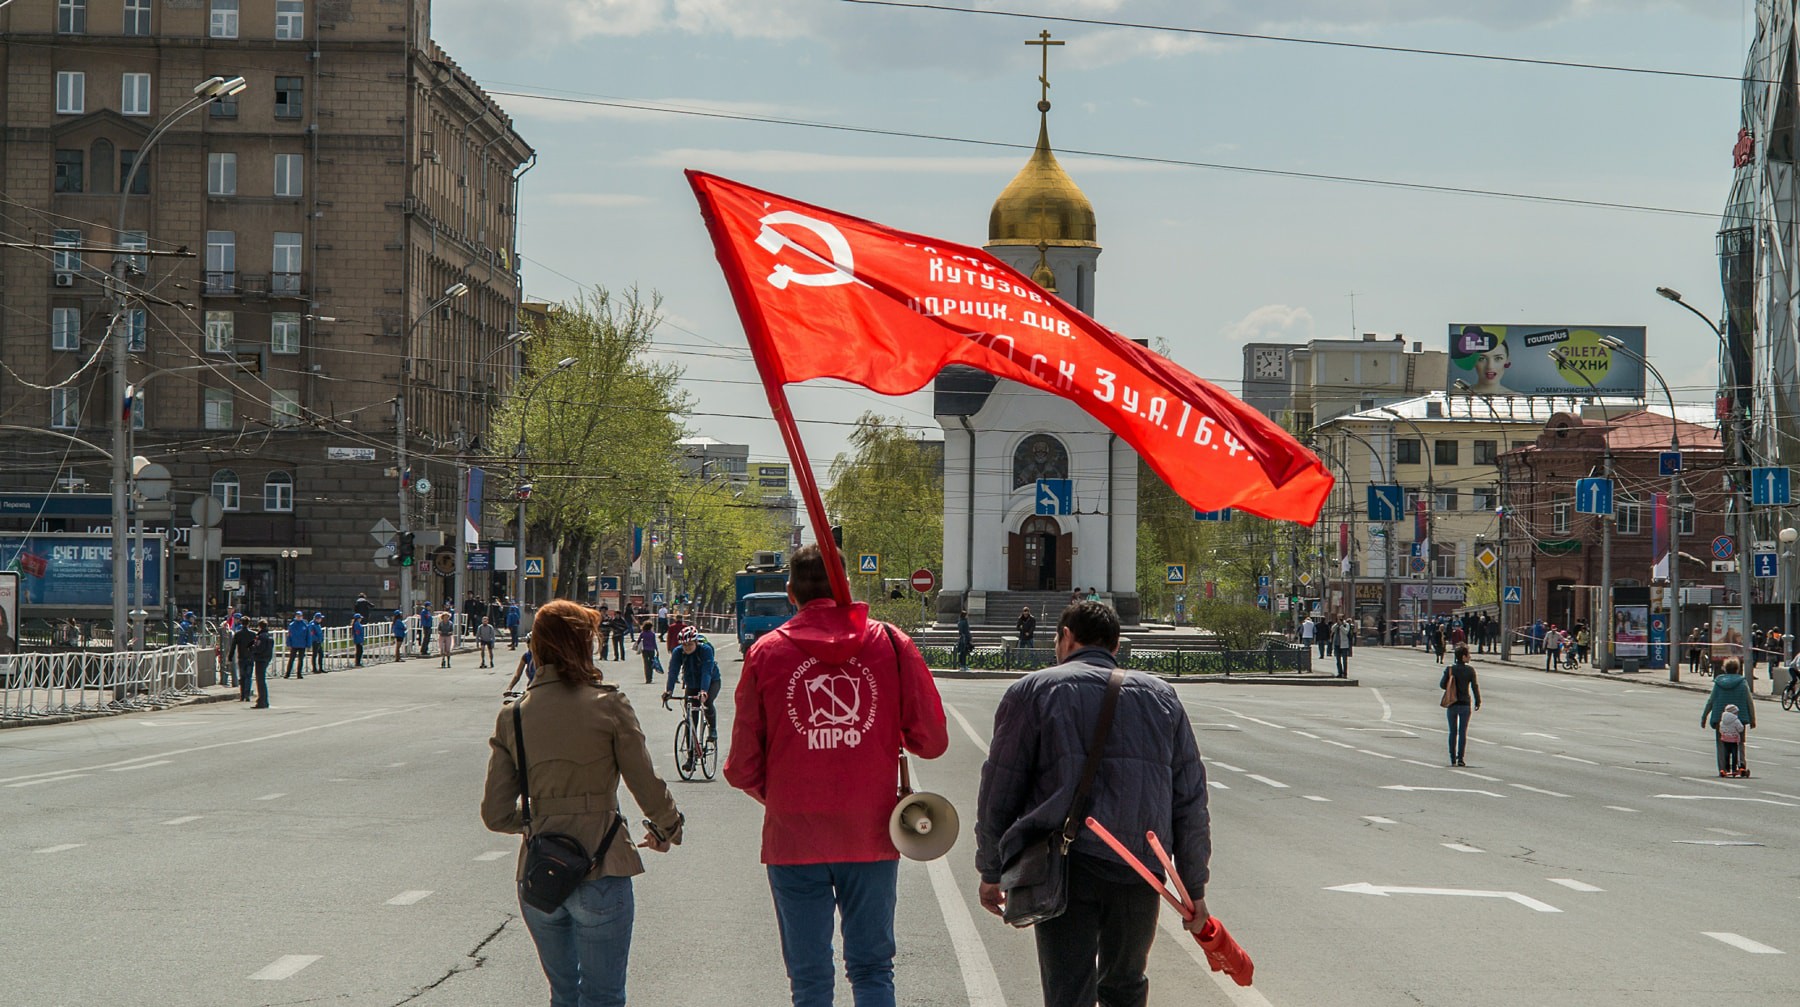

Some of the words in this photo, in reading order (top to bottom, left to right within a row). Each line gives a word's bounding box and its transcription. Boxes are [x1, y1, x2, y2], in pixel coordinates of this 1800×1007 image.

[1527, 331, 1568, 344] raumplus
[1559, 346, 1608, 357] GILETA
[1559, 360, 1608, 370] КУХНИ
[1093, 367, 1117, 402] 3
[3, 501, 31, 509] Переход
[81, 546, 112, 560] ЛЕГЧЕ
[1655, 636, 1663, 661] pepsi
[787, 707, 805, 734] ТРУД
[808, 727, 861, 749] КПРФ
